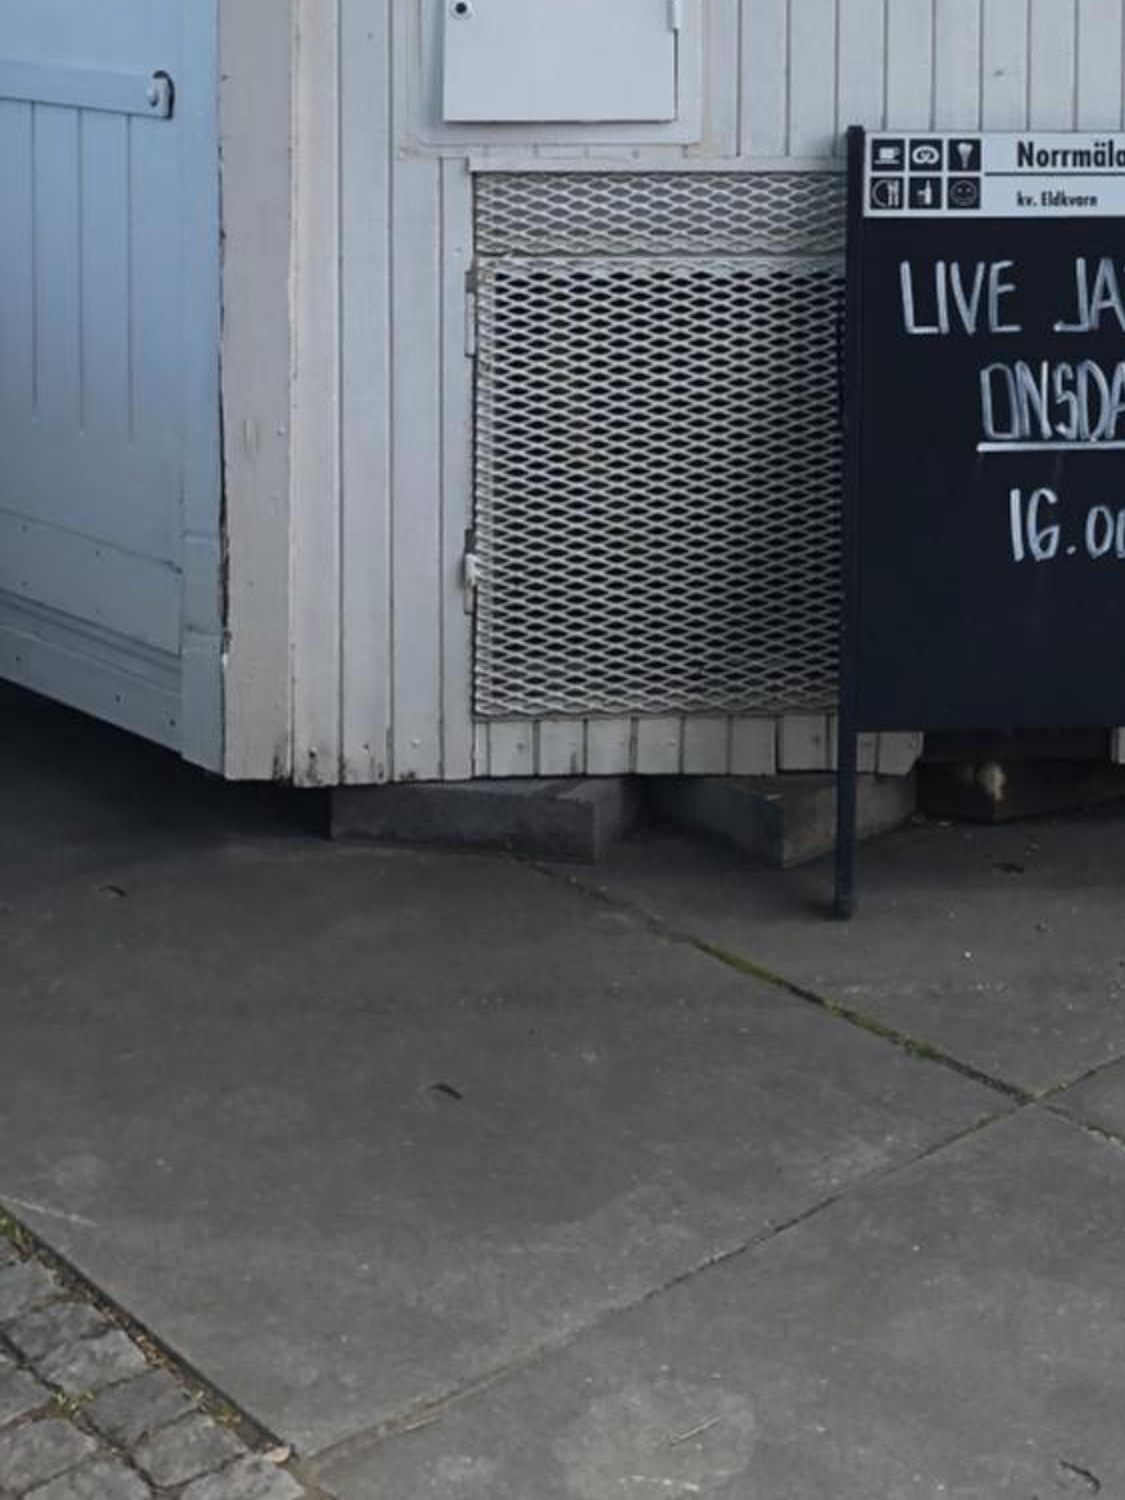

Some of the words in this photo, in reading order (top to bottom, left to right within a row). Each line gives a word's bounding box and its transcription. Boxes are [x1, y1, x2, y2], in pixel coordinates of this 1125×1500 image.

[1016, 190, 1037, 207] kv.
[1041, 190, 1098, 207] Eldkvarn
[900, 260, 1022, 335] LIVE
